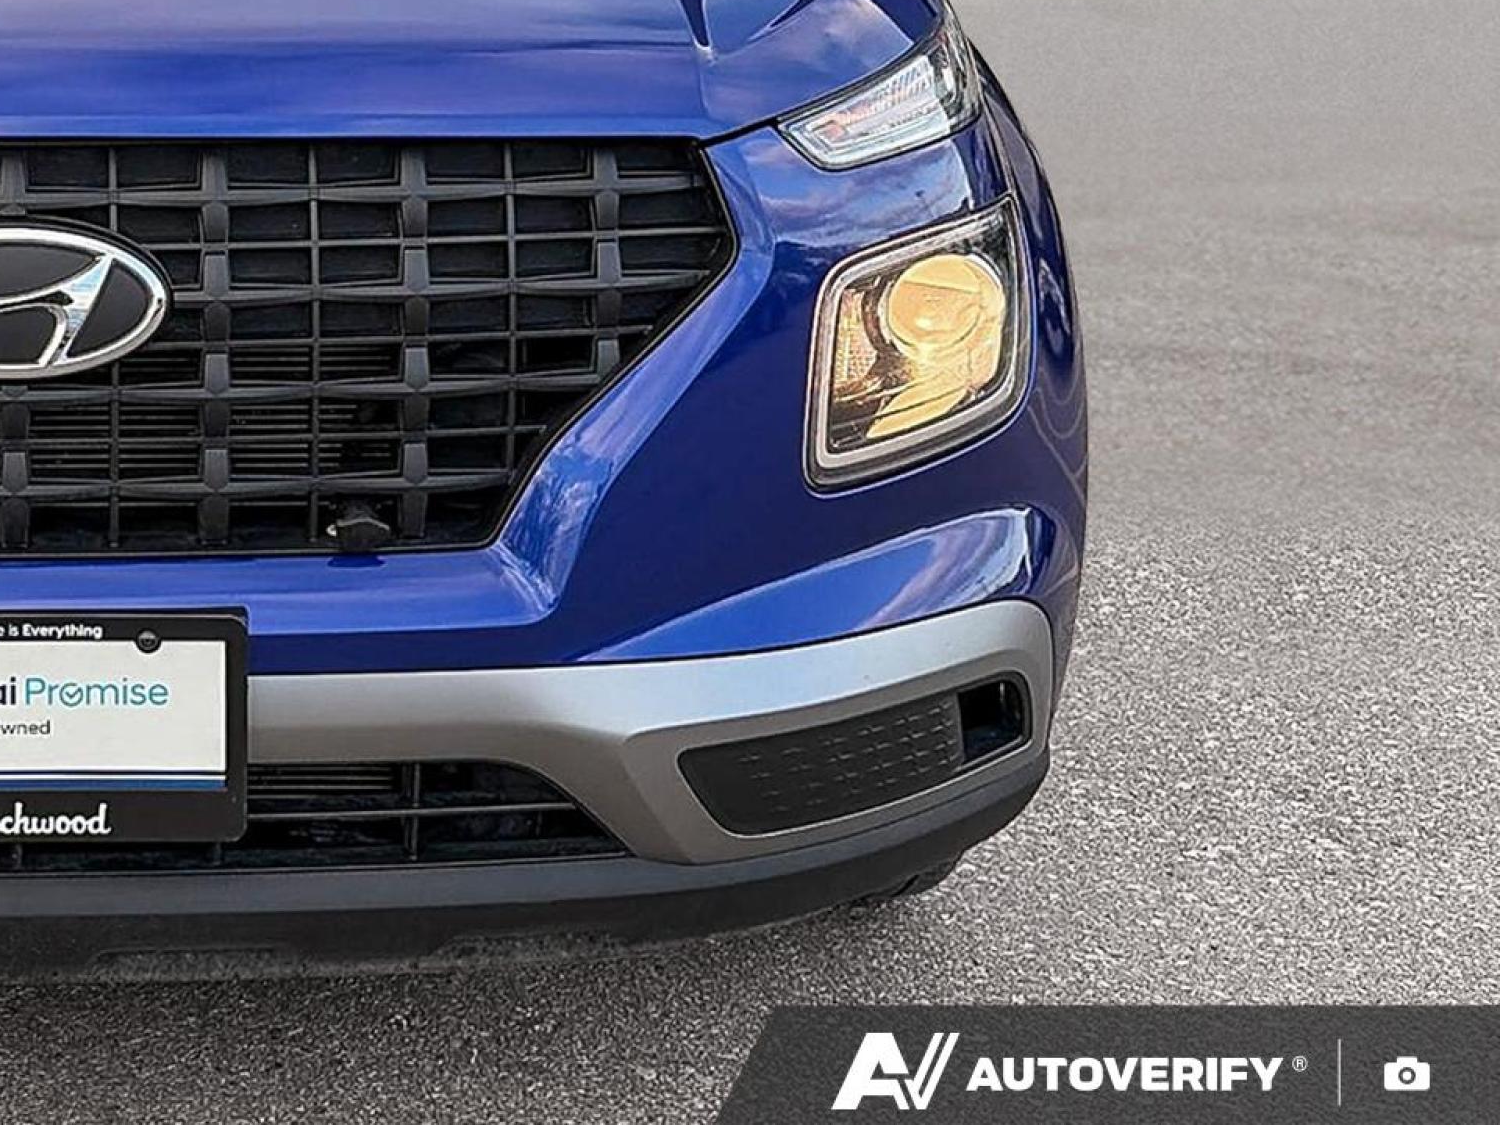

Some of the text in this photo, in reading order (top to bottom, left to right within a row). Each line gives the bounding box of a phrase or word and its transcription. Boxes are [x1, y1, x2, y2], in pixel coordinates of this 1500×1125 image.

[8, 623, 20, 637] is
[22, 623, 103, 639] Everything
[25, 677, 169, 707] Promise
